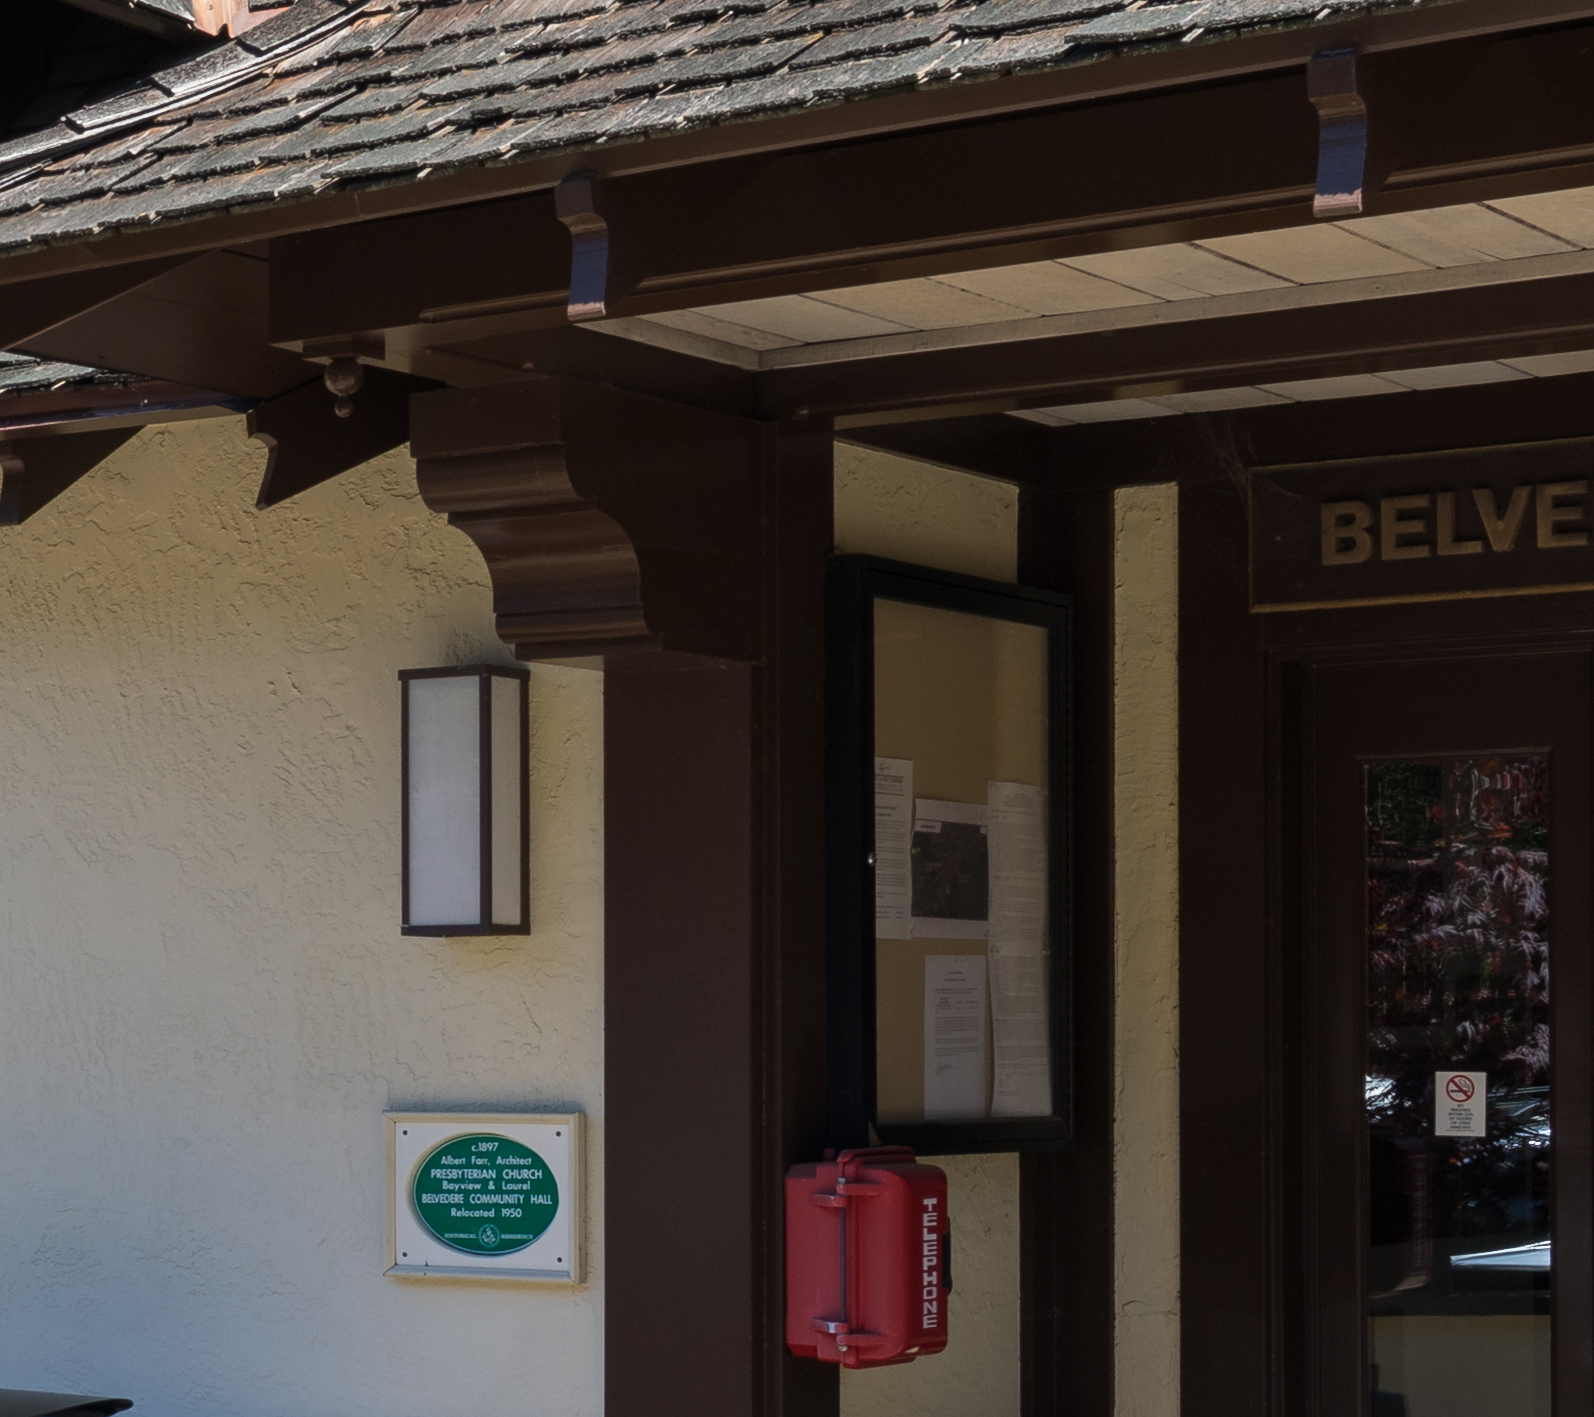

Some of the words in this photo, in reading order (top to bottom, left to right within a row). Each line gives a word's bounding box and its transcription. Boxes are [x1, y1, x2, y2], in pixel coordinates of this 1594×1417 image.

[440, 1155, 466, 1165] Albert
[471, 1156, 491, 1166] Farr,
[496, 1156, 532, 1165] Architect
[430, 1169, 496, 1179] PRESBYTERIAN
[502, 1169, 543, 1180] CHURCH
[442, 1180, 482, 1192] Bayview
[487, 1180, 496, 1190] &
[501, 1180, 531, 1190] Laurel
[421, 1193, 464, 1204] BELVEDERE
[469, 1194, 525, 1204] COMMUNITY
[530, 1194, 553, 1205] HALL
[450, 1207, 495, 1218] Relocated
[501, 1208, 523, 1218] 1950
[922, 1197, 938, 1330] TELEPHONE
